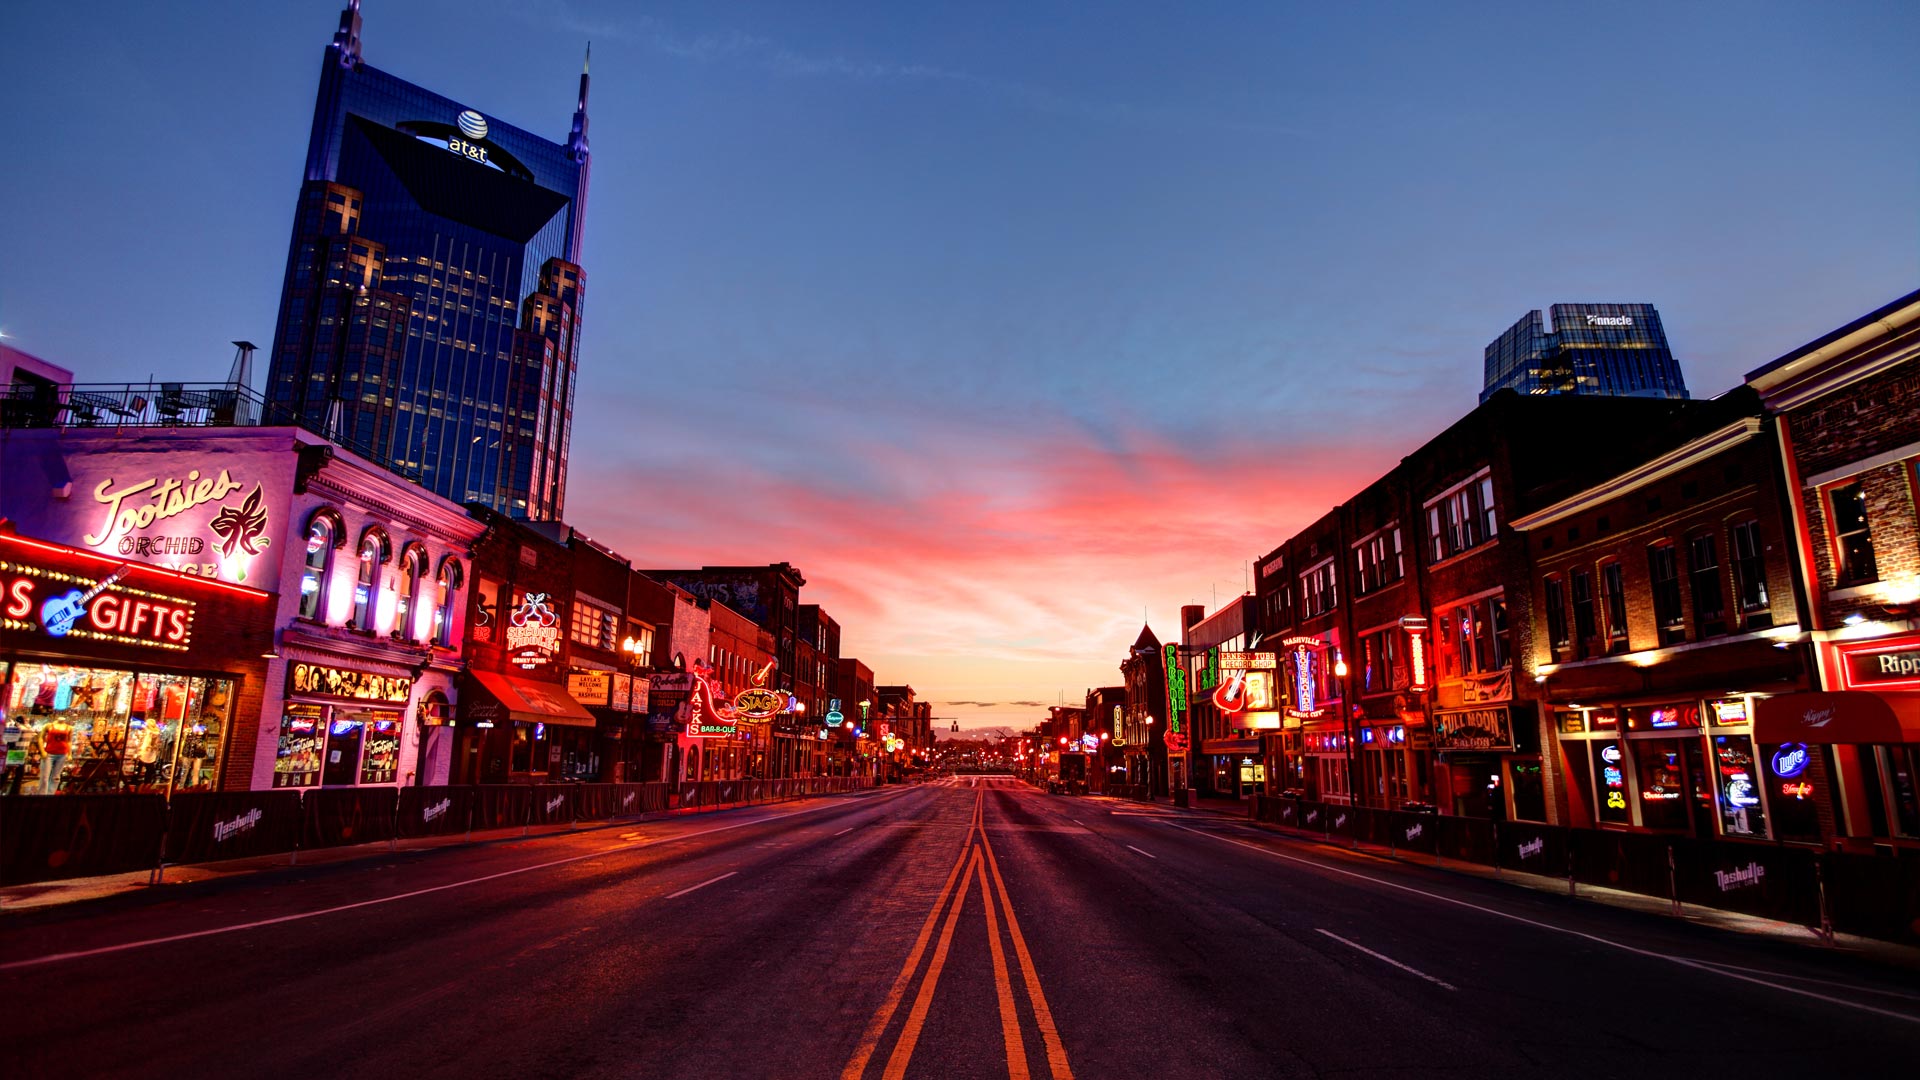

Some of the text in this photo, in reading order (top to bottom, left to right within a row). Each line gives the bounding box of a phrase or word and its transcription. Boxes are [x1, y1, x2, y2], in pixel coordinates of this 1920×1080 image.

[449, 138, 487, 162] at&t
[1586, 315, 1632, 326] Pinnacle
[83, 469, 242, 546] Tootsies
[118, 535, 204, 557] ORCHID
[91, 595, 186, 641] GIFTS
[507, 627, 557, 639] SECOND
[508, 637, 554, 651] FIDDLE
[1282, 636, 1320, 646] NASHVILLE
[1221, 652, 1275, 660] ERNEST TUBB
[1225, 660, 1272, 668] RECORD SHOP
[1177, 669, 1186, 710] PARK
[1298, 645, 1310, 711] CROSSROADS
[738, 692, 779, 711] STAGE
[1441, 713, 1466, 739] FULL
[1467, 710, 1500, 738] MOON
[1778, 749, 1805, 774] Lite
[214, 808, 263, 842] Nashville
[1714, 861, 1765, 892] Nashville
